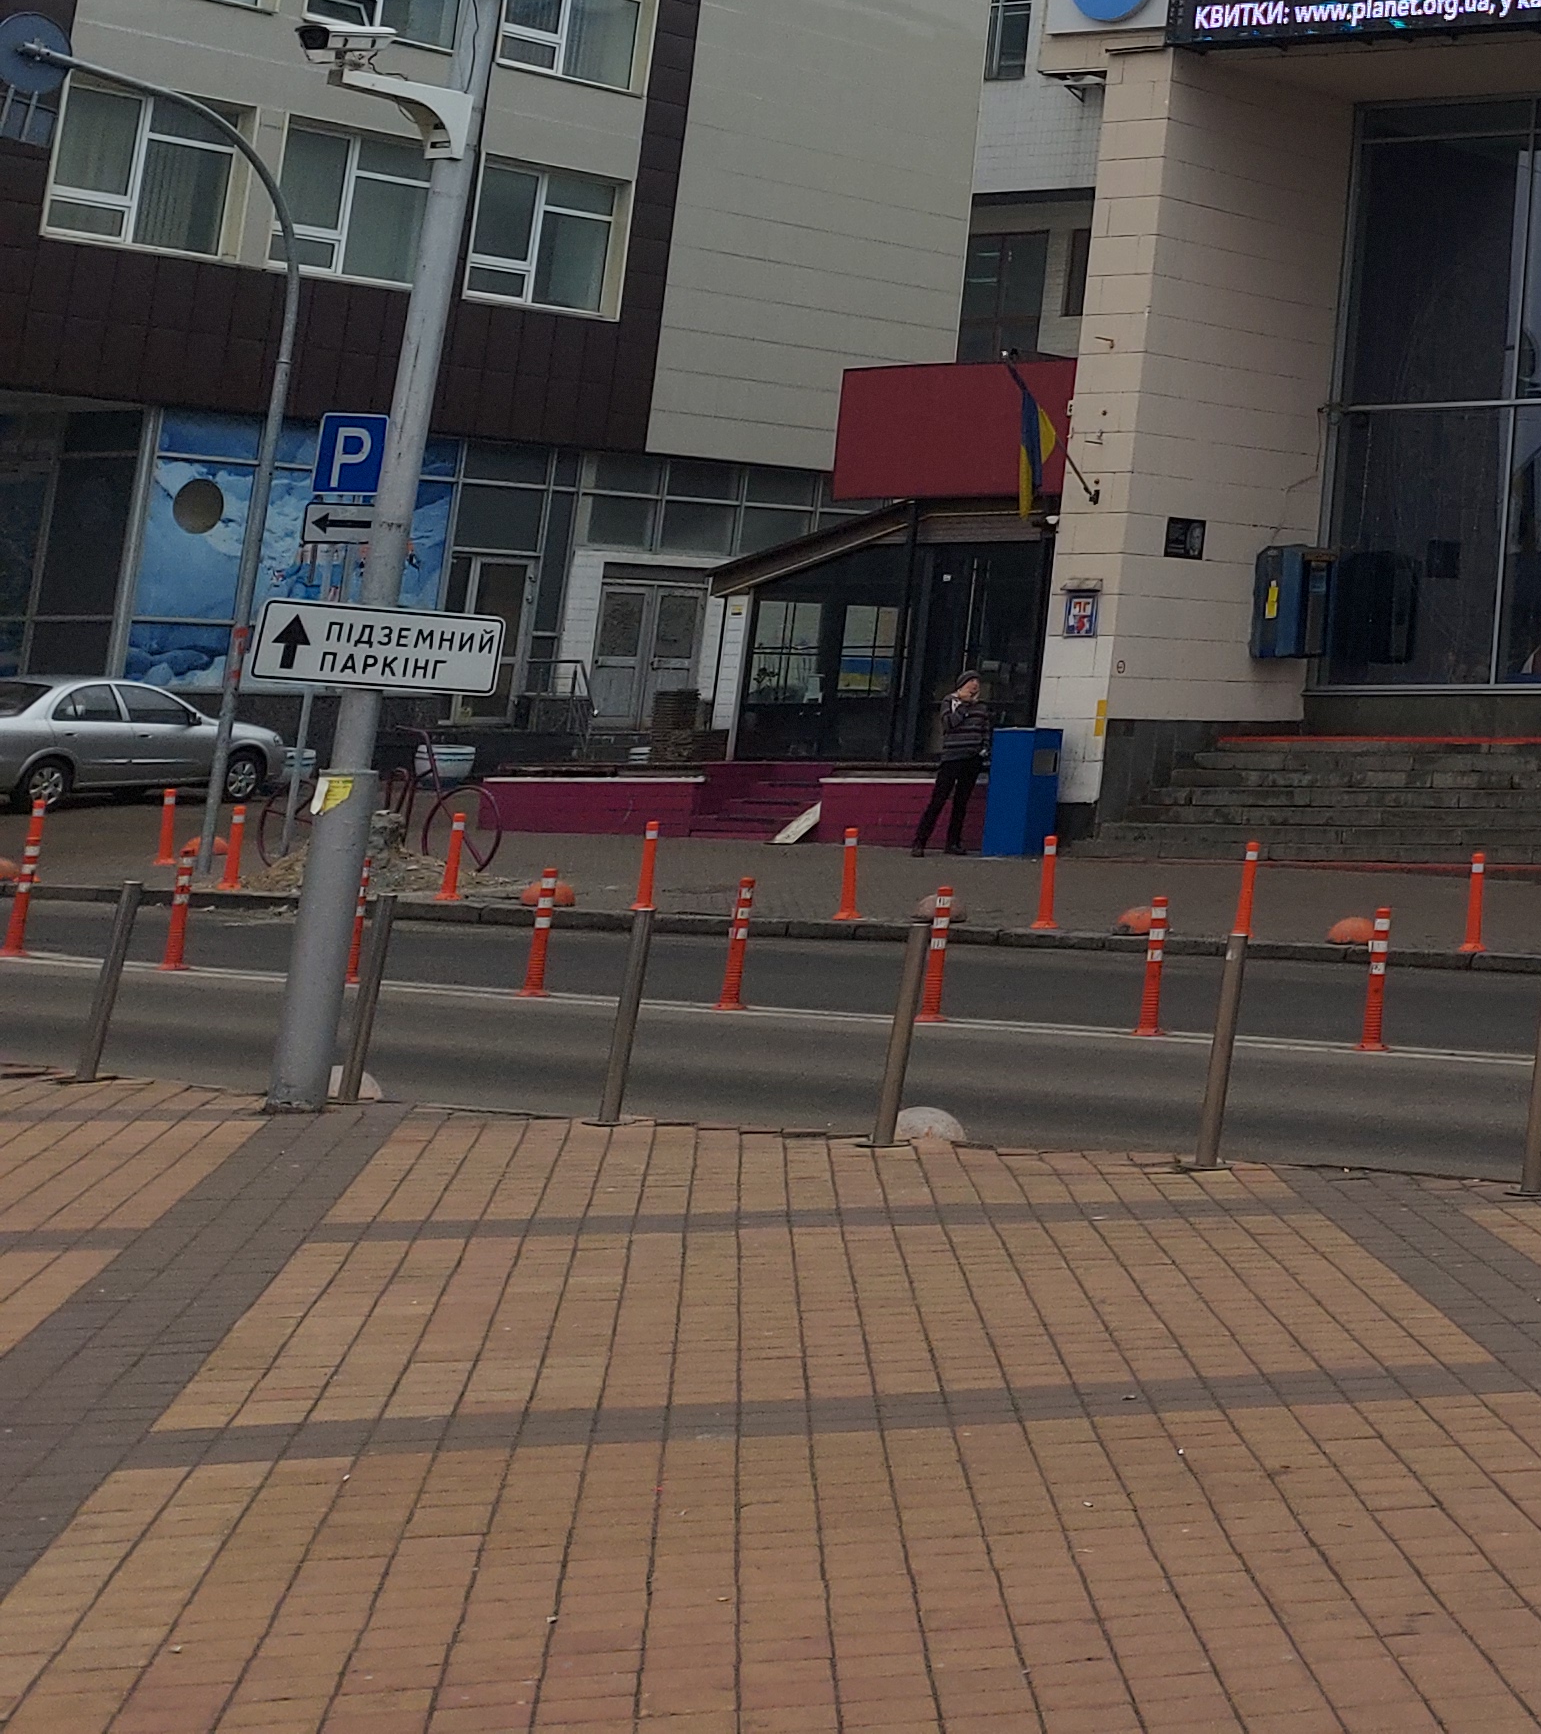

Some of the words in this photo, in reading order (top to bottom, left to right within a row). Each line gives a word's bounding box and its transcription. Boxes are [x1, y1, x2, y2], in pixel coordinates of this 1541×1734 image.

[1194, 0, 1290, 30] КВИТКИ:
[328, 426, 373, 488] P
[325, 620, 496, 655] ПІДЗЕМНИЙ
[319, 651, 448, 681] ПАРКІНГ
